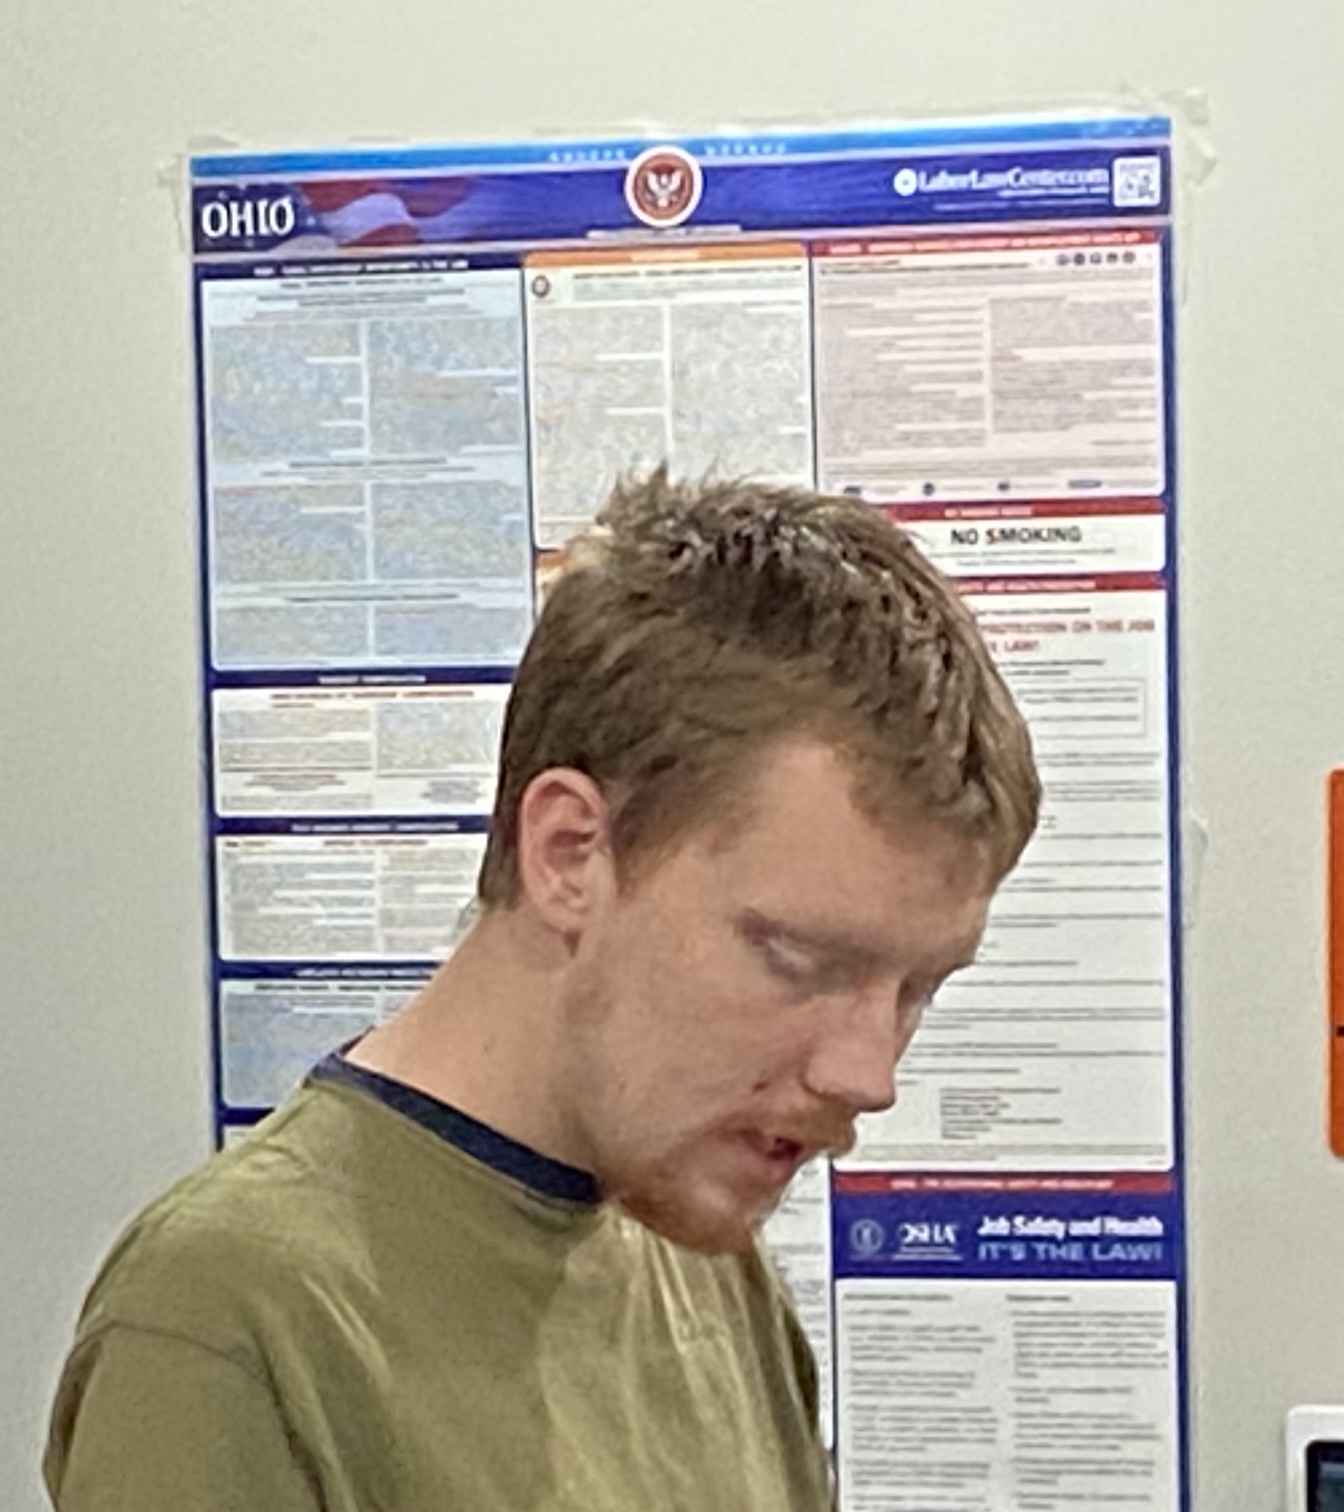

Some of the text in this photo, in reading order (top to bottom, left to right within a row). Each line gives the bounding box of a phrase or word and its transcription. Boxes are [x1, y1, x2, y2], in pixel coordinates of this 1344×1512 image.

[201, 197, 295, 238] OHIO
[950, 525, 1082, 545] NO SMOKING
[977, 1212, 1164, 1239] Job Safety and Health
[978, 1242, 1026, 1261] IT'S
[1031, 1242, 1085, 1261] THE
[1091, 1242, 1163, 1261] LAW!
